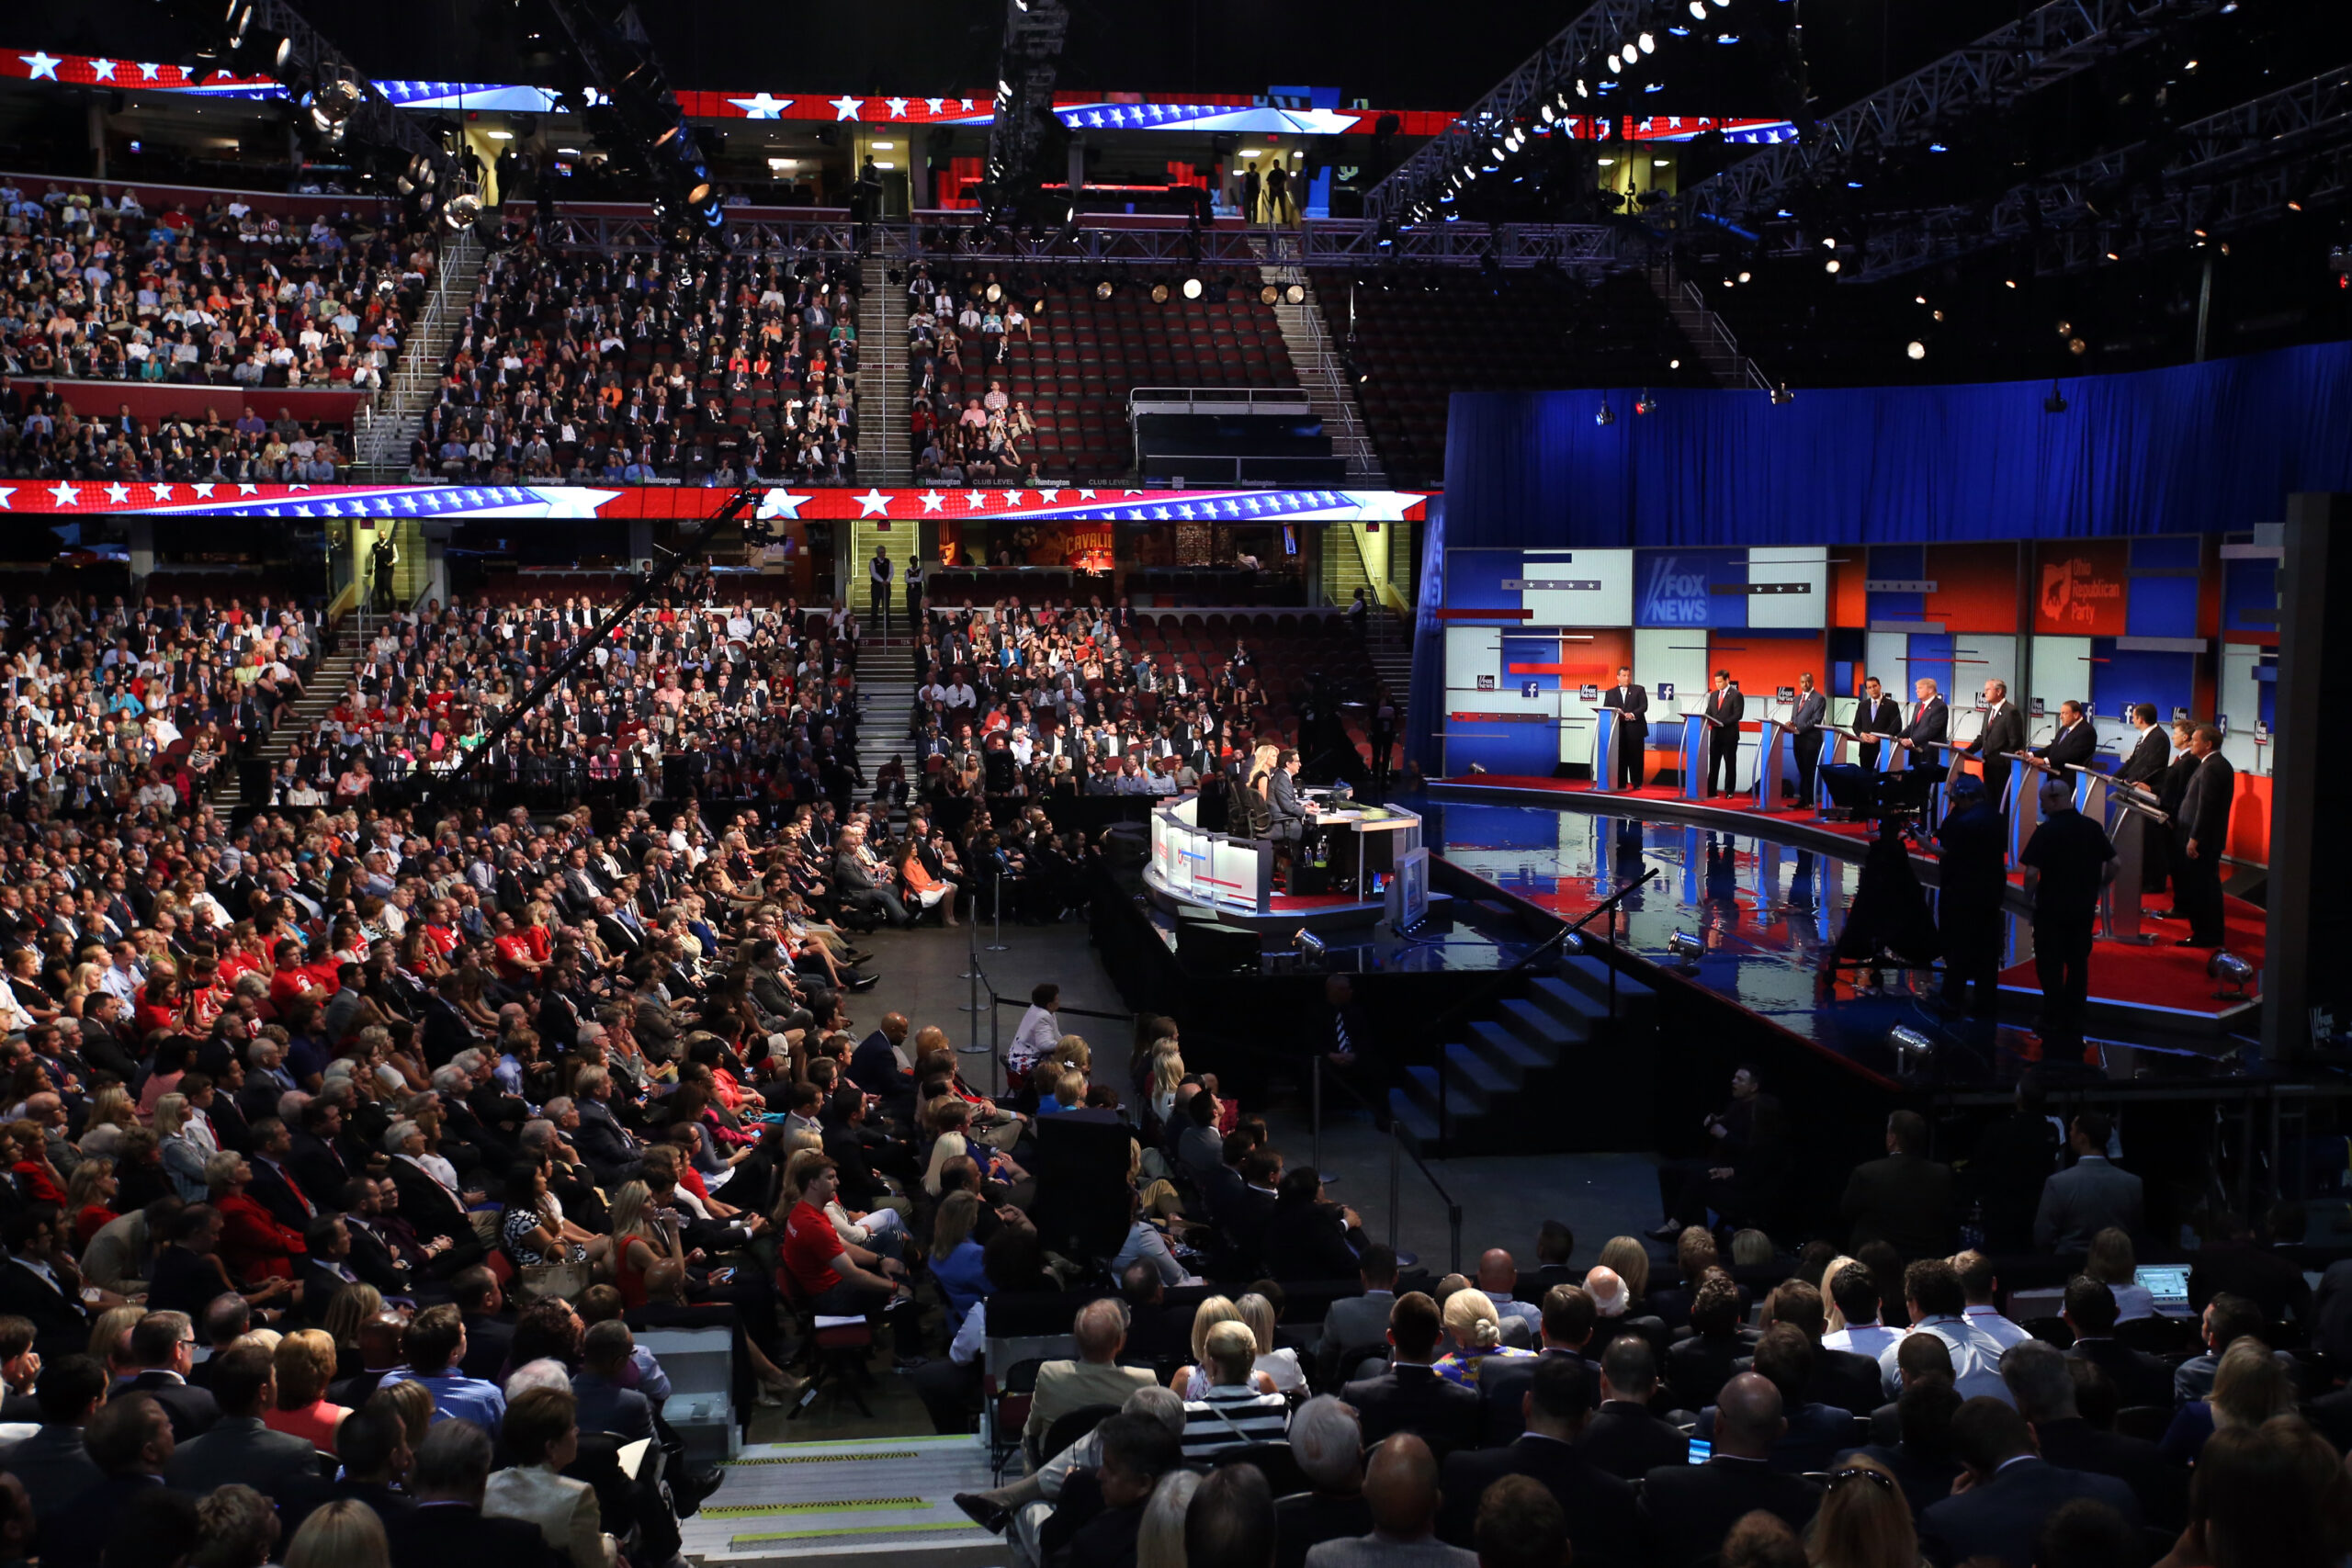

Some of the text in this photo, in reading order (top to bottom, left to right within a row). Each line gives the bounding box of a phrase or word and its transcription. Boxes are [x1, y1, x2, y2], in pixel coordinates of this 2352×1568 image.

[411, 476, 448, 485] Huntington
[528, 476, 566, 485] Huntington
[644, 476, 681, 486] Huntington
[758, 477, 794, 486] Huntington
[925, 478, 961, 487] Huntington
[1035, 479, 1070, 487] Huntington
[2074, 558, 2092, 576] Ohio
[1665, 574, 1706, 598] FOX
[2073, 578, 2120, 603] Republican
[1652, 599, 1707, 622] NEWS
[2072, 602, 2095, 626] Party
